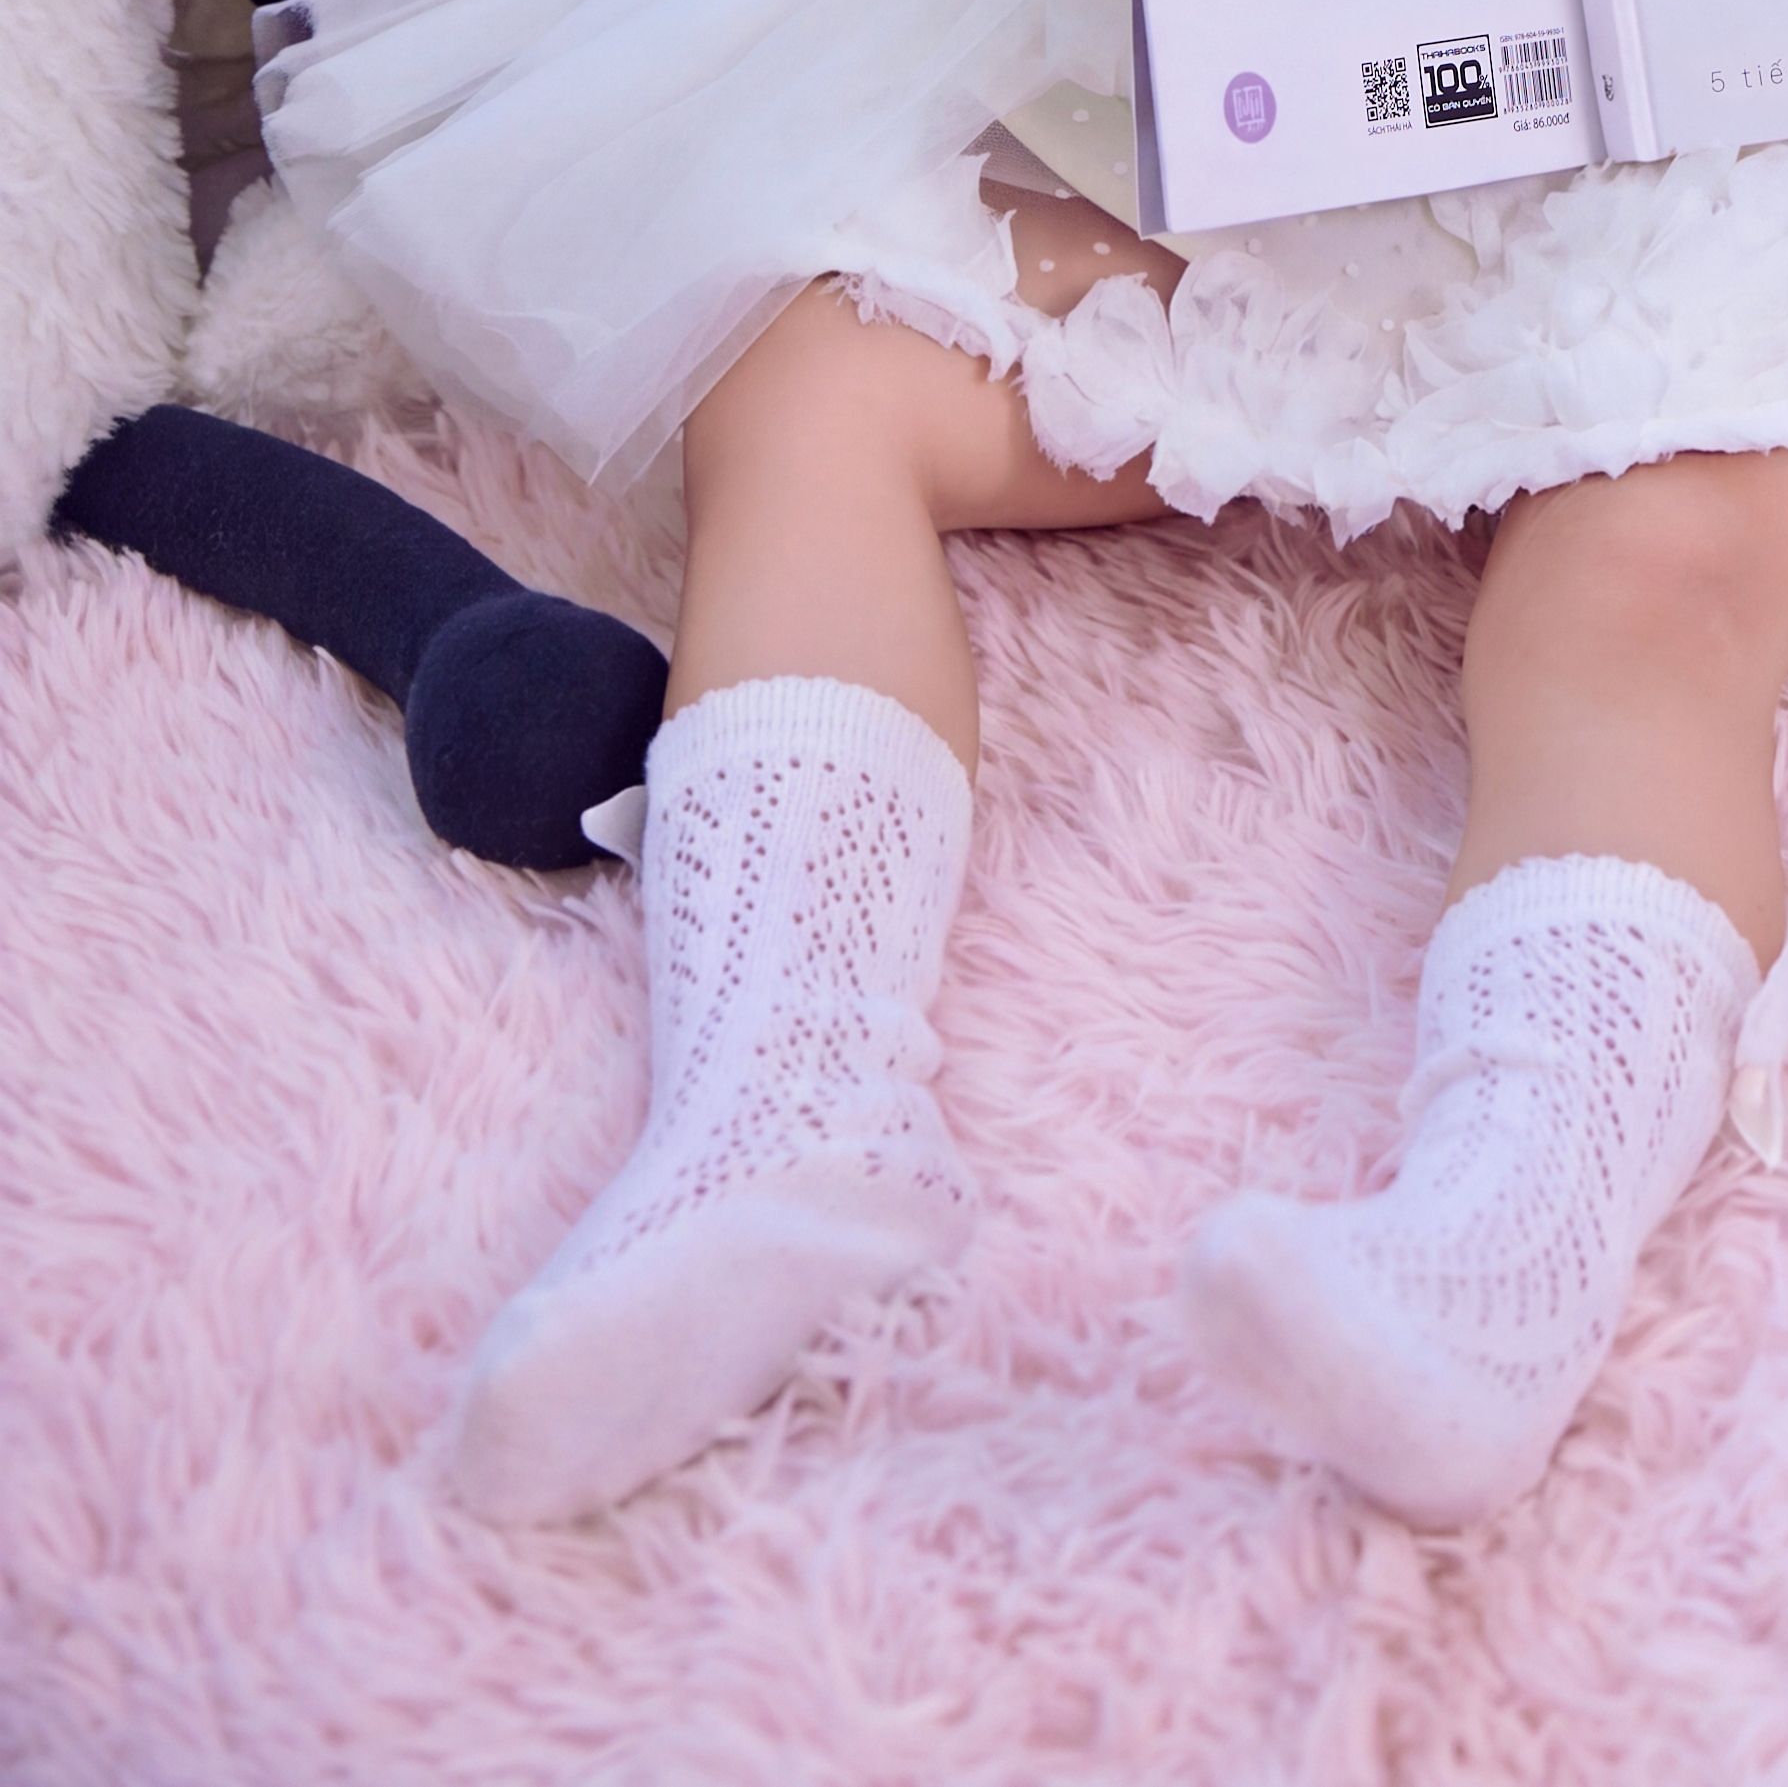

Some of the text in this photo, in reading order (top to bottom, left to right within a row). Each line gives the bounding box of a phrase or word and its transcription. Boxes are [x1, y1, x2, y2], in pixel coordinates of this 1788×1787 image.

[1420, 44, 1487, 61] THAIHABOOKS
[1709, 69, 1726, 93] 5
[1512, 113, 1571, 133] Giá: 86.000đ
